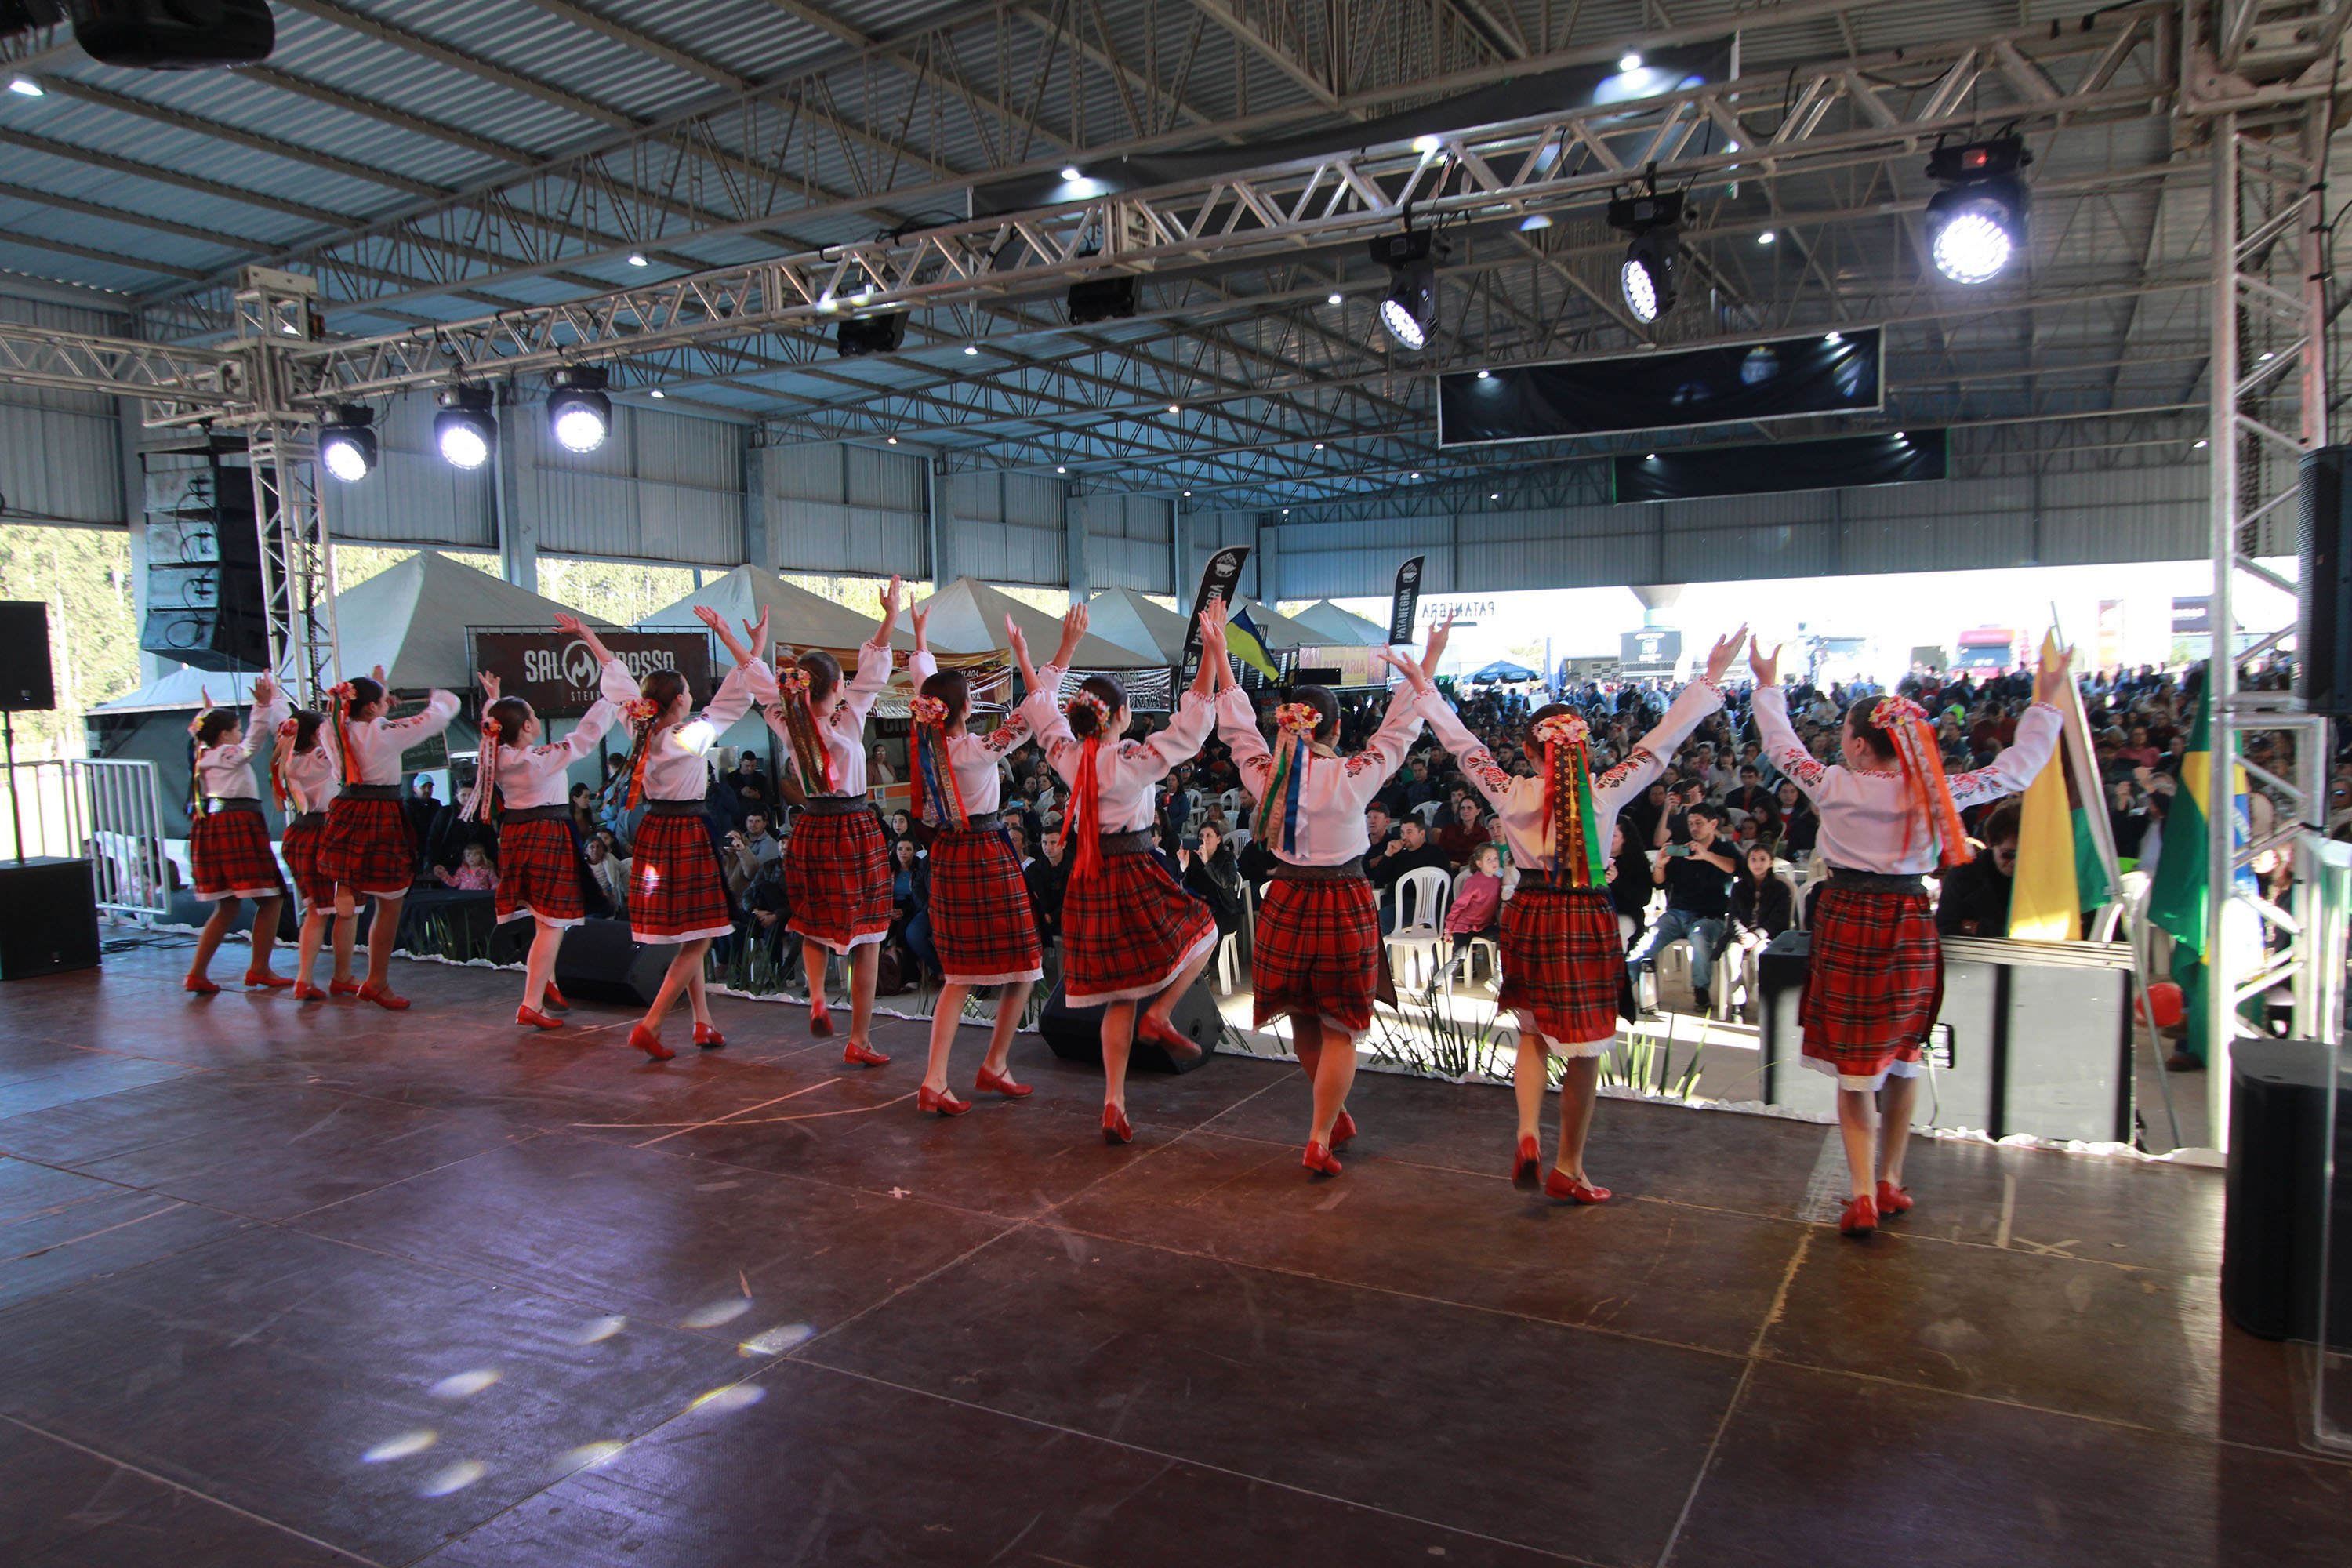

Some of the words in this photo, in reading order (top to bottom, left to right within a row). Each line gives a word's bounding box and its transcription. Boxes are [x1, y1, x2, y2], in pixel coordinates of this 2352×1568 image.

[1395, 588, 1411, 639] PATANEGRA
[524, 650, 563, 682] SAL
[879, 699, 901, 707] CHEIRO
